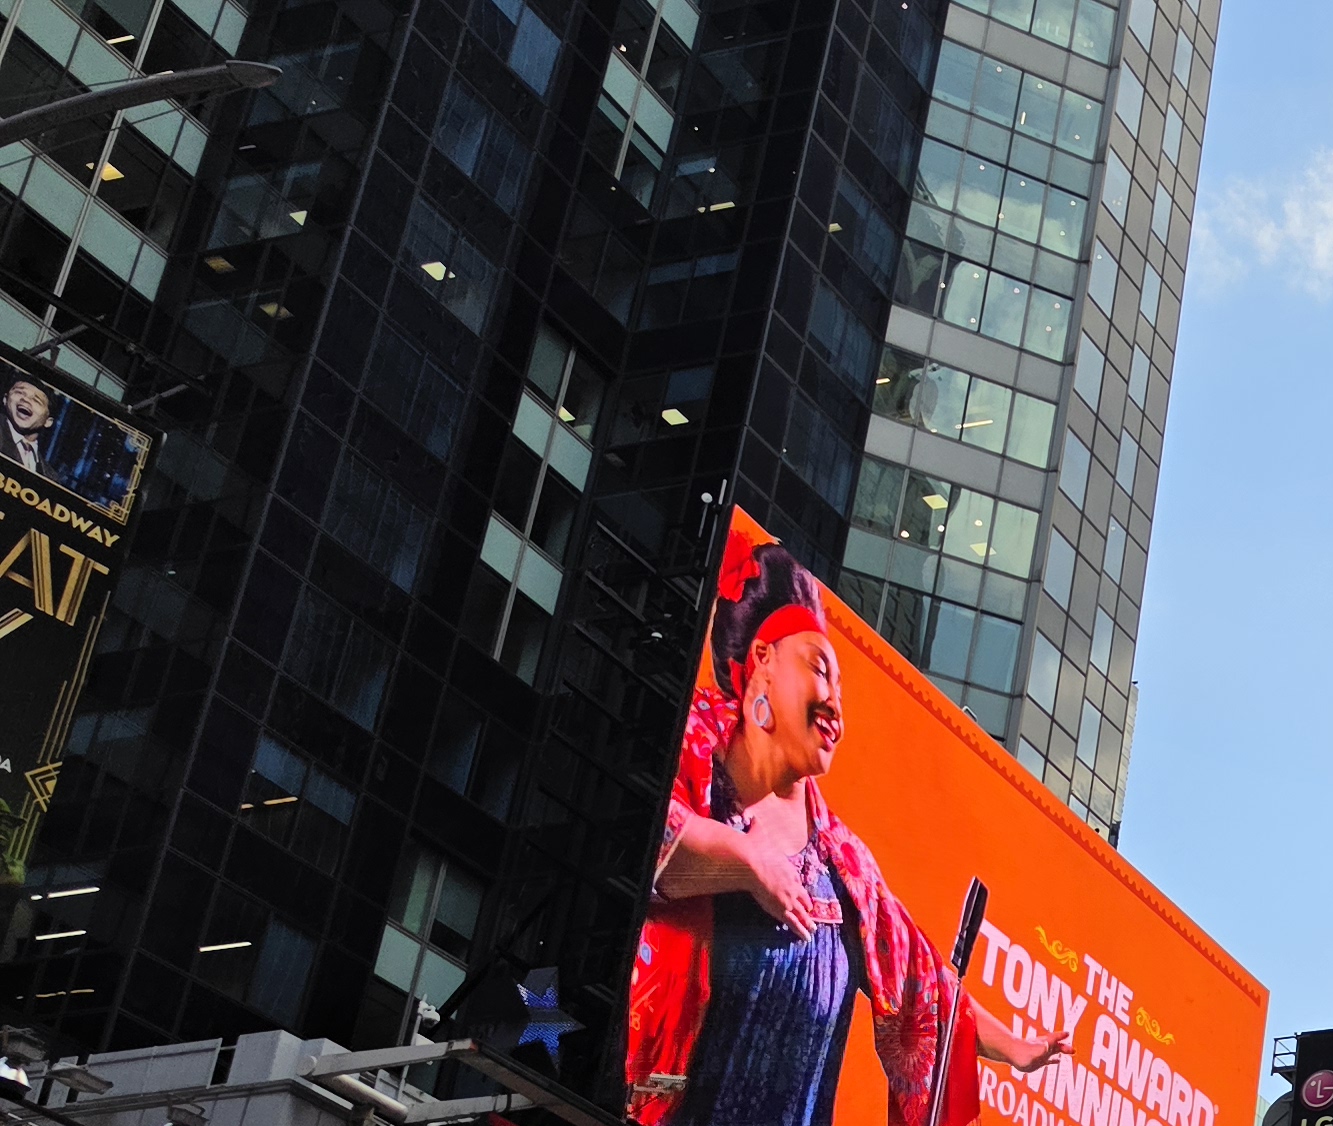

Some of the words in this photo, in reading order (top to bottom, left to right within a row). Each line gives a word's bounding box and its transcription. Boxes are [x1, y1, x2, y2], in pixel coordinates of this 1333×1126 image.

[0, 528, 109, 628] AT
[980, 918, 1088, 1046] TONY
[1083, 952, 1134, 1026] THE
